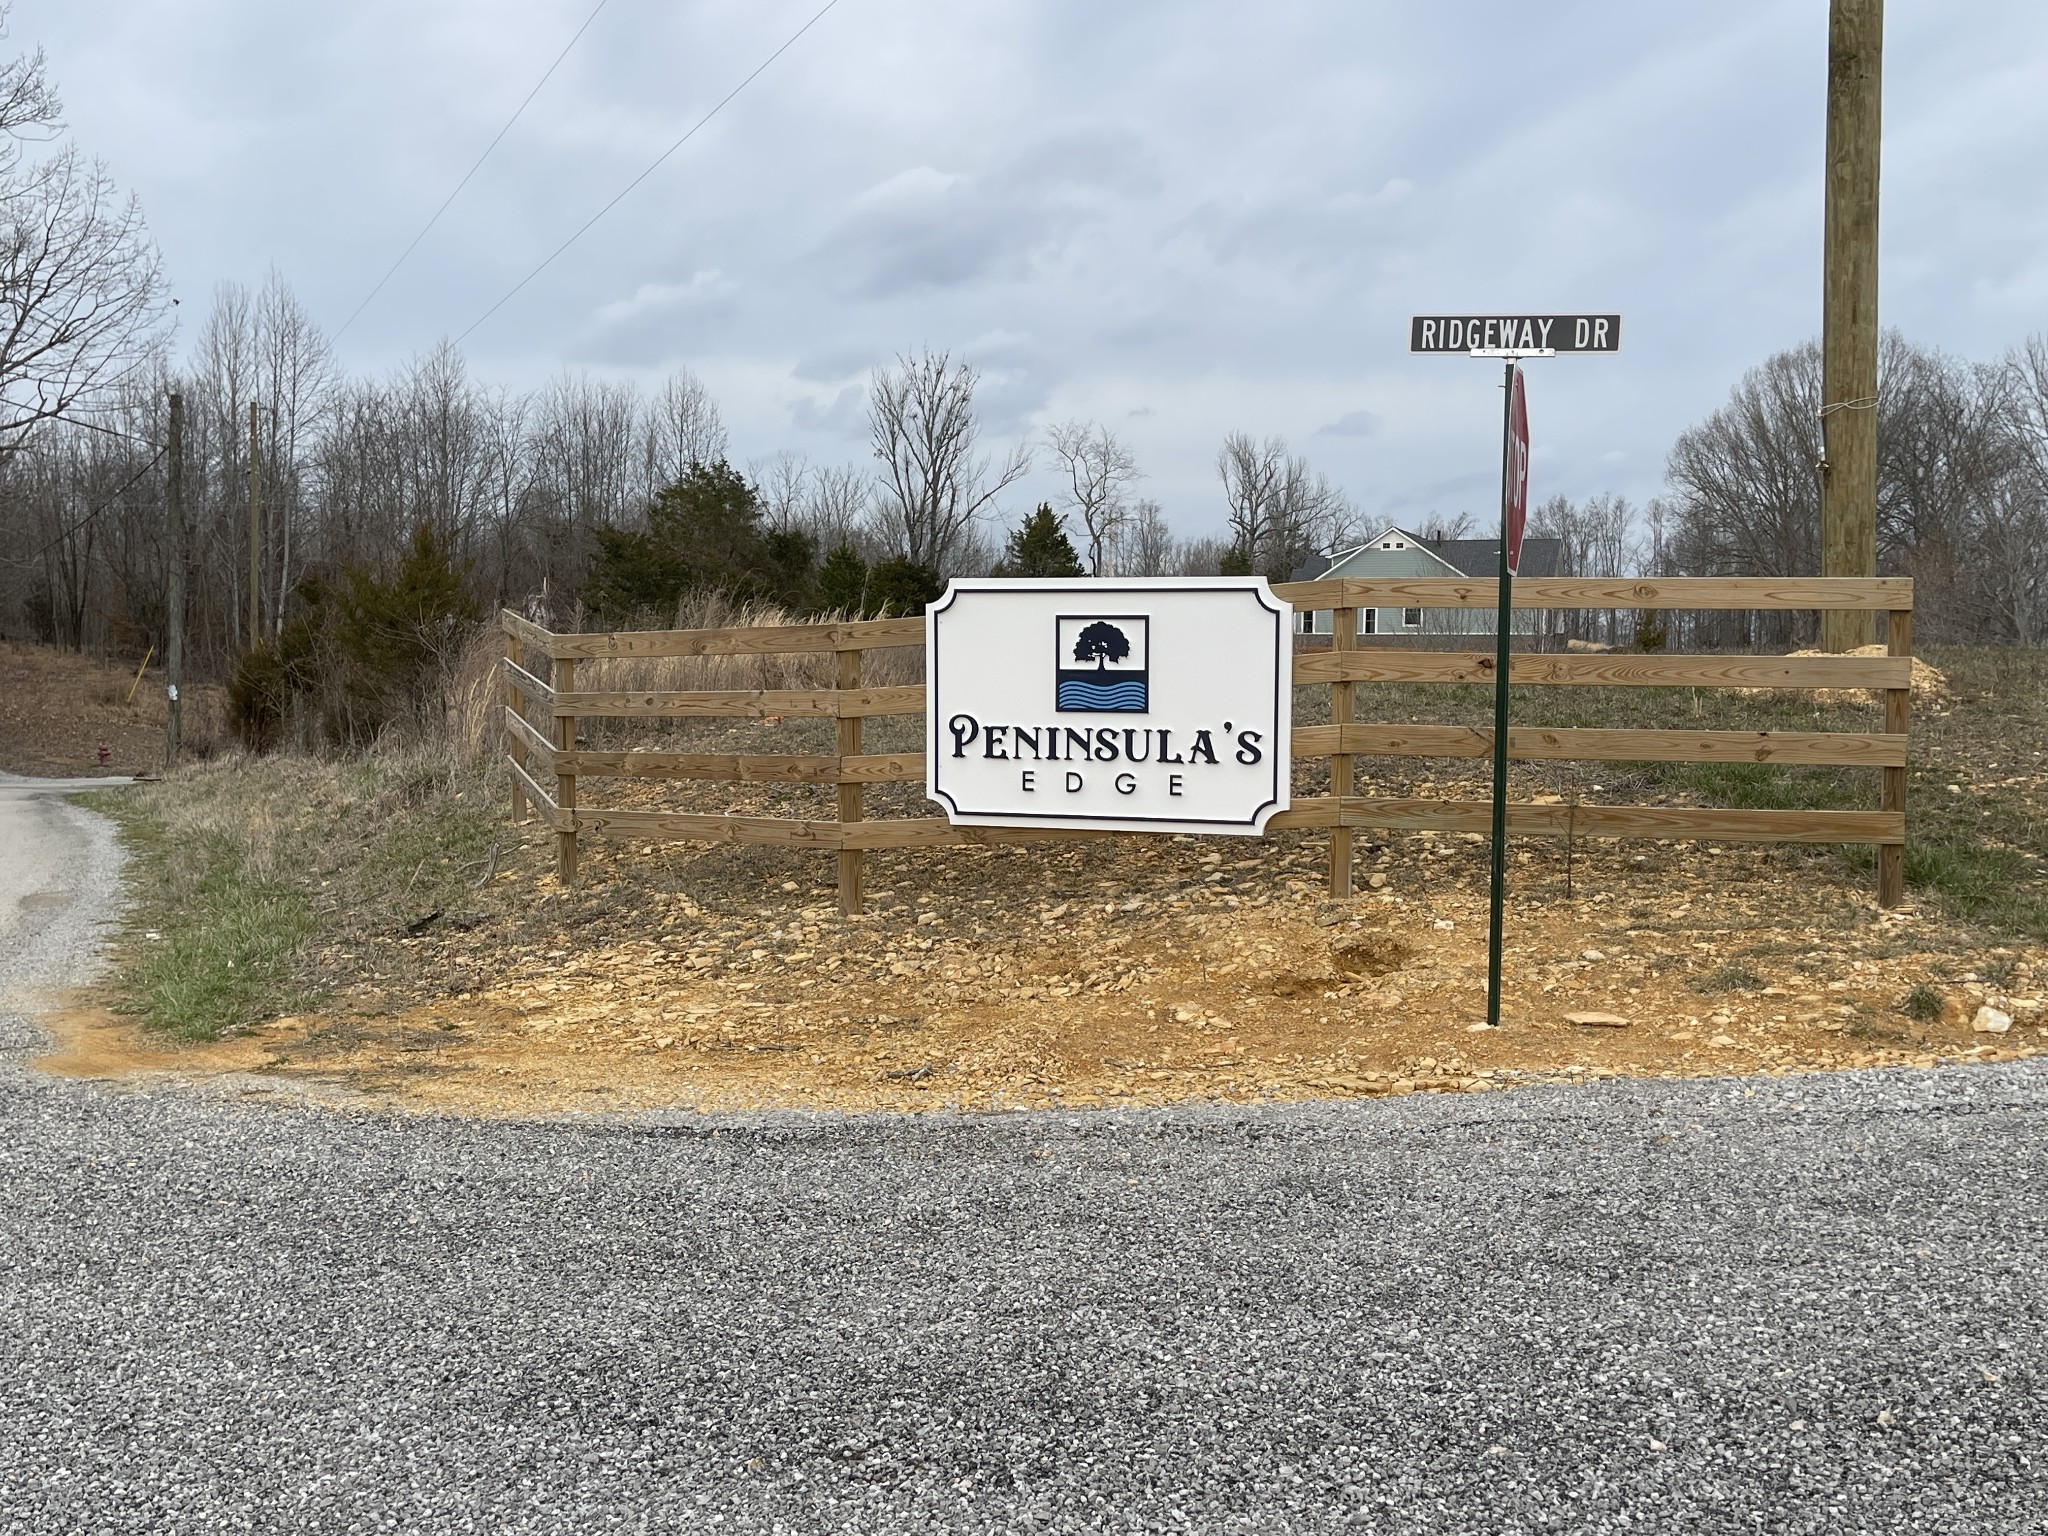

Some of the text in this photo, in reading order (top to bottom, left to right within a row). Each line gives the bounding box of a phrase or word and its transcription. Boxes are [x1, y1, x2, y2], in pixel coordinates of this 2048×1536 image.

[1421, 318, 1609, 349] RIDGEWAY DR
[1507, 429, 1526, 510] OP
[1022, 770, 1183, 797] EDGE
